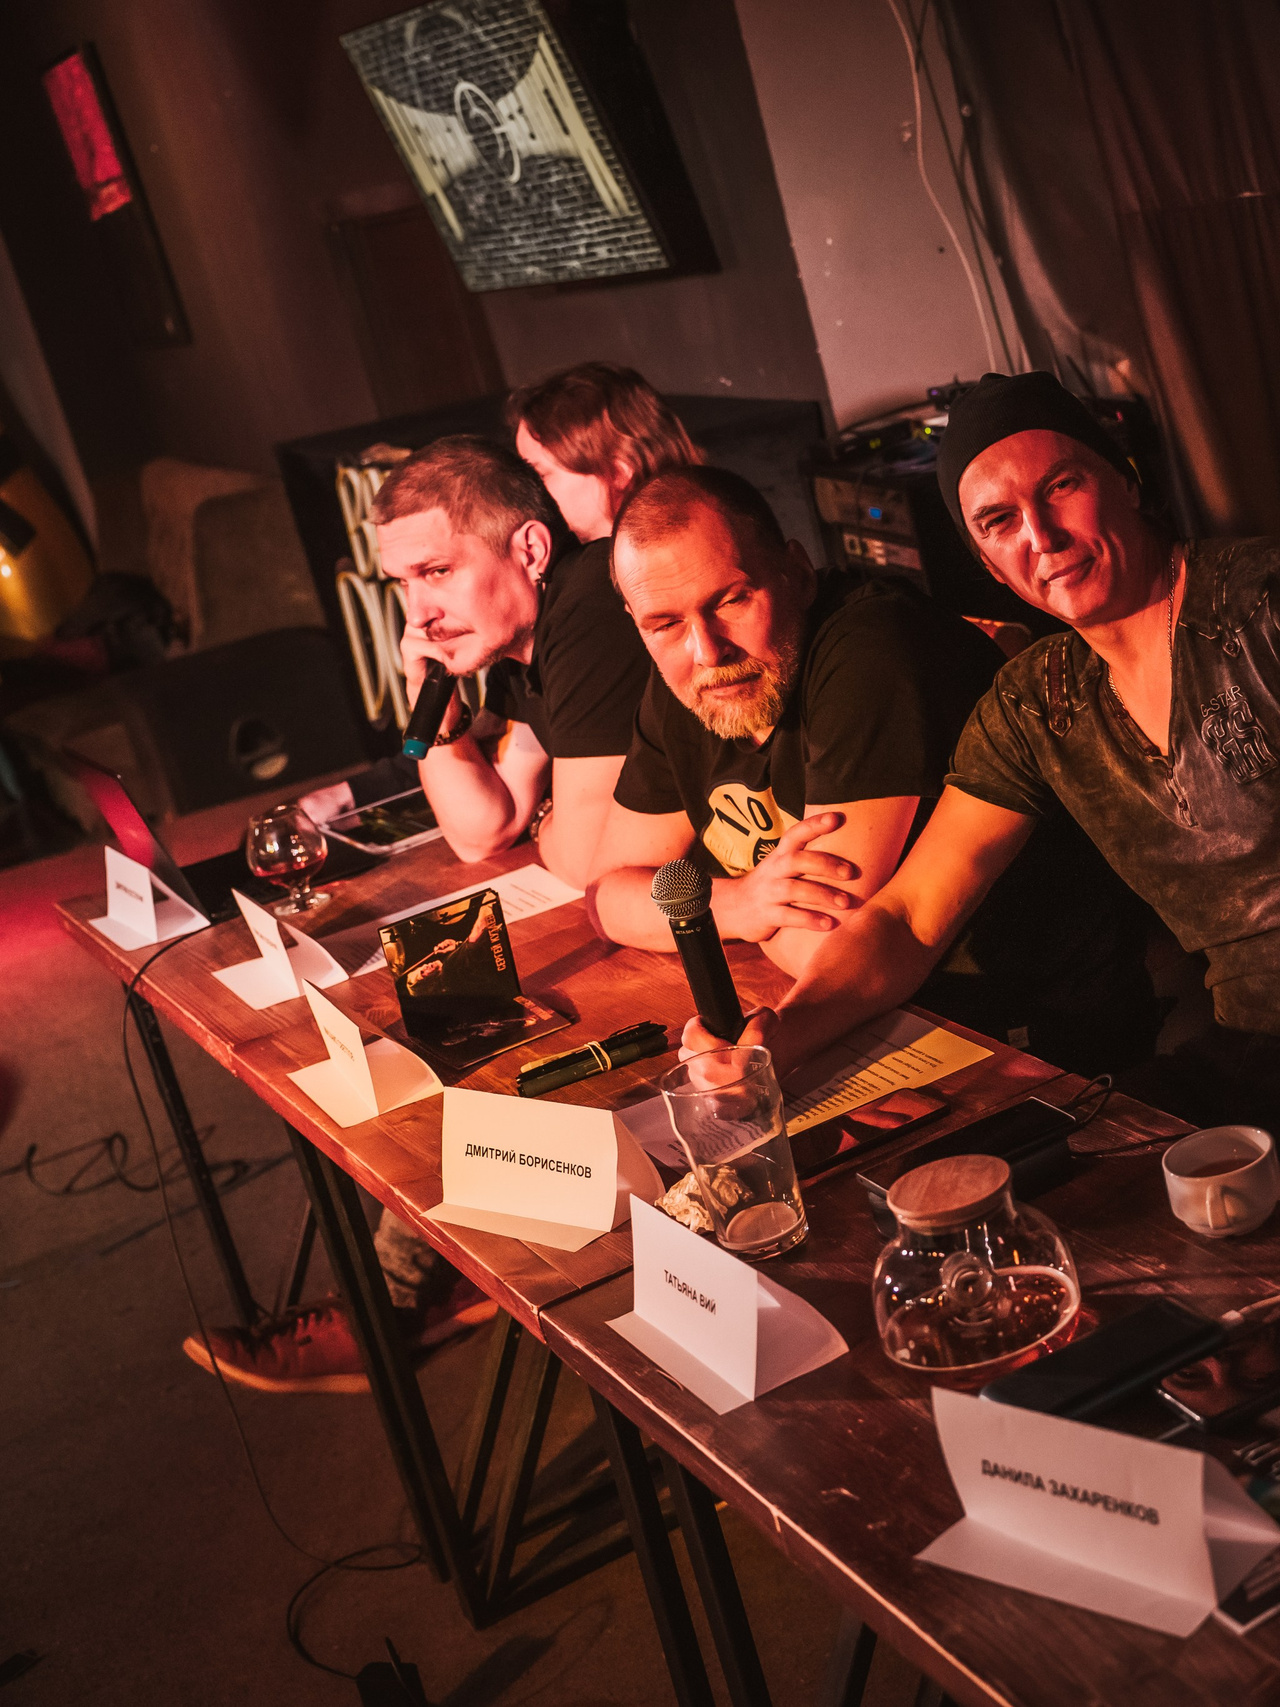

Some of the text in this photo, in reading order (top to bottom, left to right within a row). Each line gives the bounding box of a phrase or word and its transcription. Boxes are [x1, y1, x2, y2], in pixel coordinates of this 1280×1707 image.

[491, 943, 506, 972] СЕРГЕЙ
[465, 1143, 592, 1179] ДМИТРИЙ БОРИСЕНКОВ
[663, 1269, 716, 1316] ТАТЬЯНА ВИЙ
[981, 1458, 1160, 1526] ДАНИЛА ЗАХАРЕНКОВ
